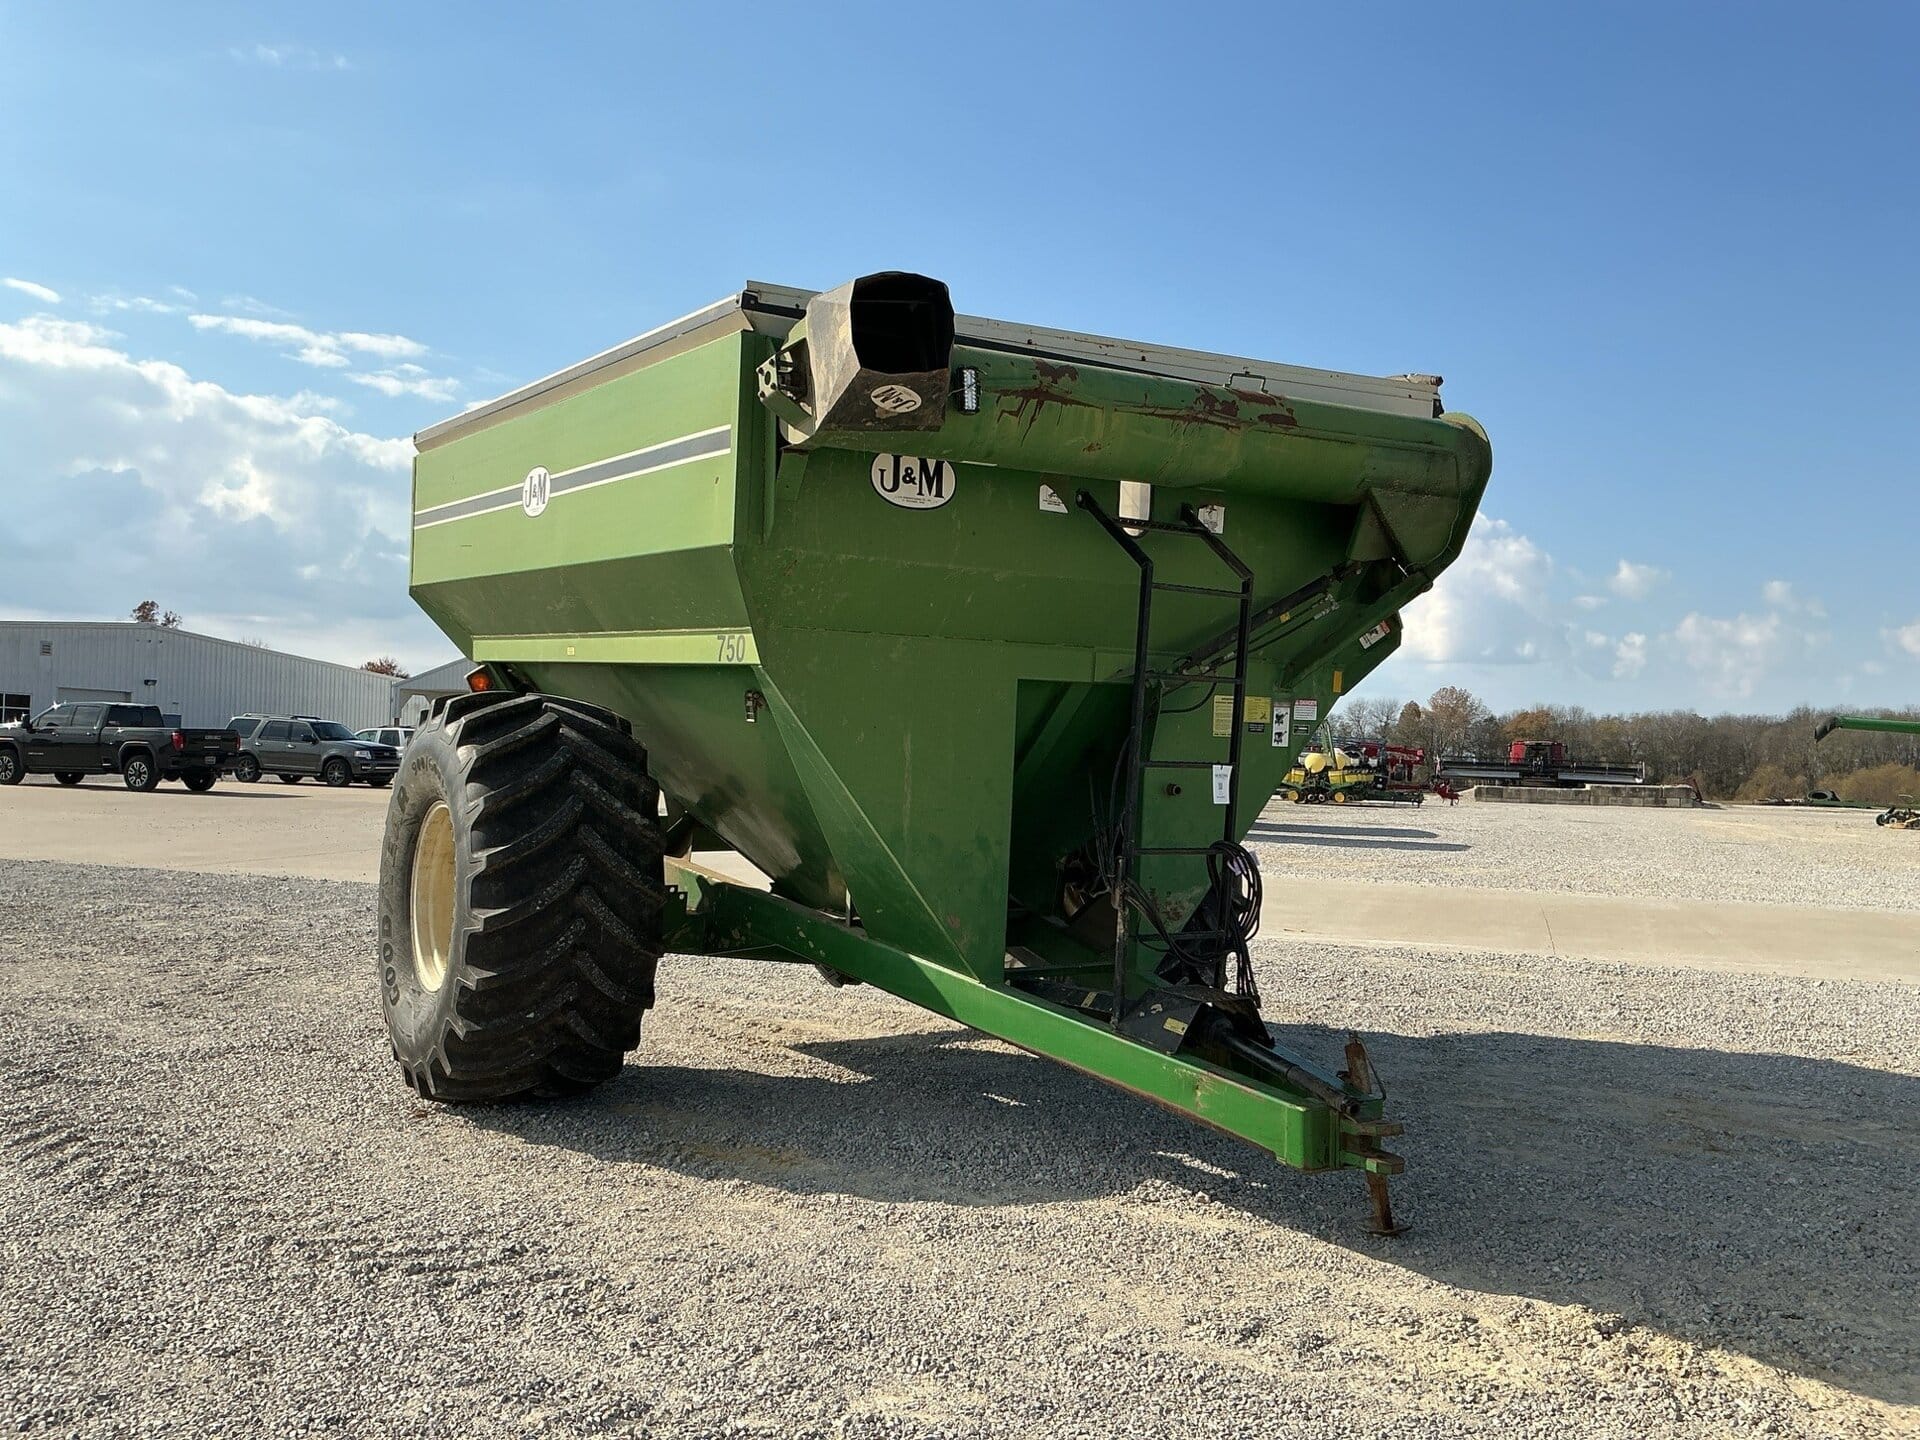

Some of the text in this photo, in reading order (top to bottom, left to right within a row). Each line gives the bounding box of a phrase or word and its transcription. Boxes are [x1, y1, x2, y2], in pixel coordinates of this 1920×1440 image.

[872, 386, 917, 410] J&M
[524, 472, 547, 507] J&M
[878, 454, 946, 498] J&M
[717, 634, 746, 662] 750
